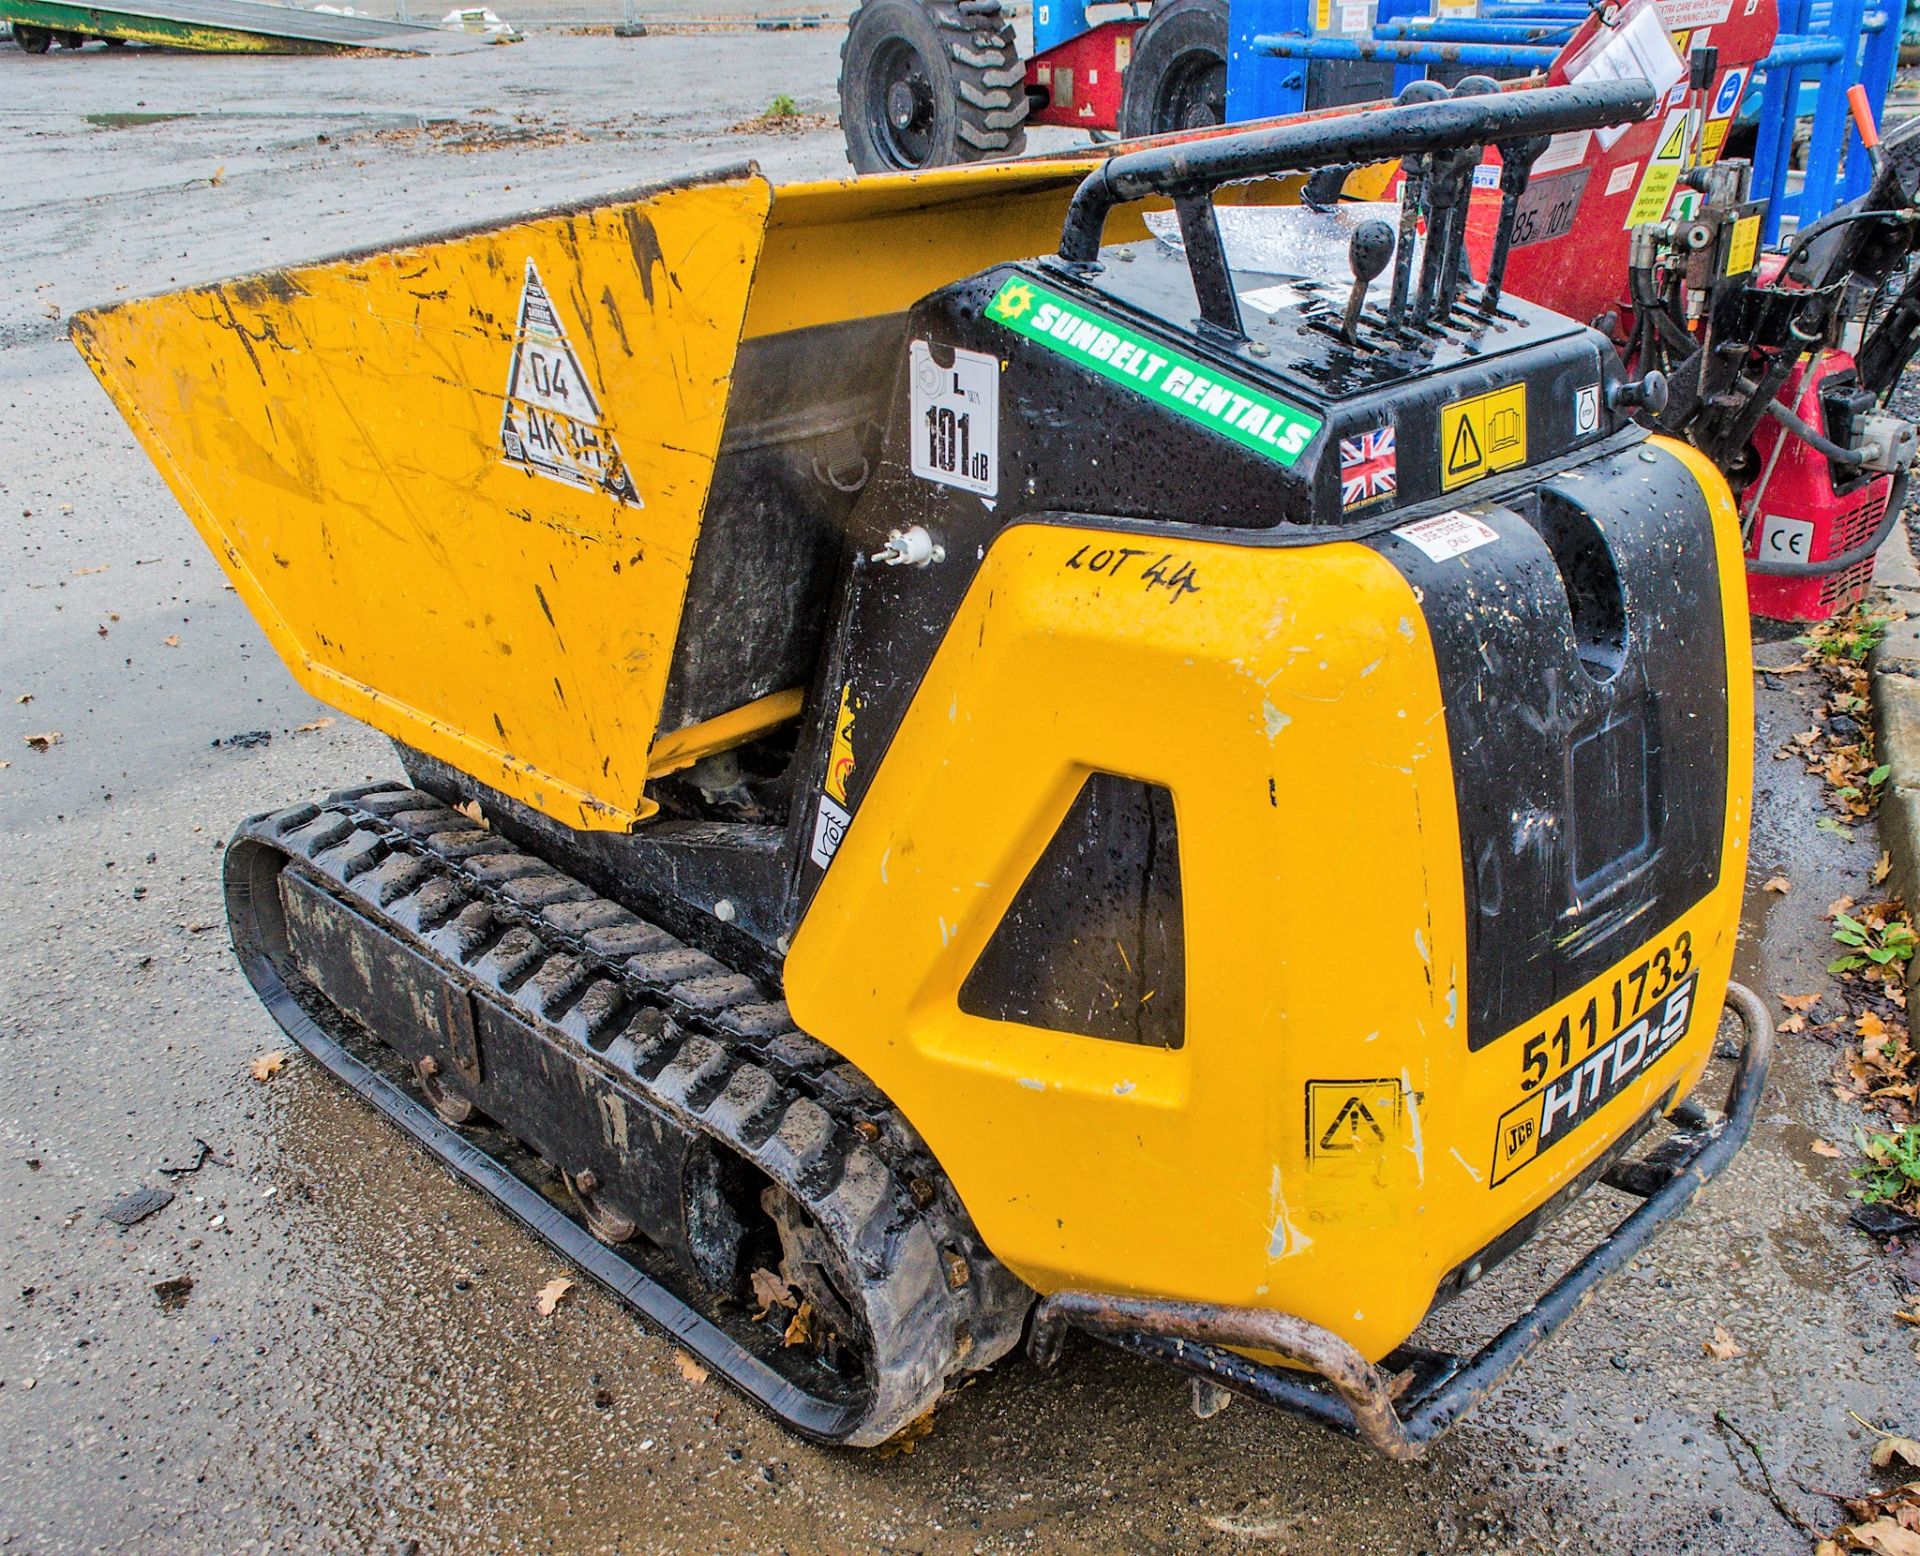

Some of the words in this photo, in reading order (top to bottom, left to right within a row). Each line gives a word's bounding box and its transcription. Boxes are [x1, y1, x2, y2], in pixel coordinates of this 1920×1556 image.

[1510, 209, 1538, 244] 85
[1546, 200, 1572, 235] 101
[530, 351, 569, 400] 04
[1030, 303, 1168, 382] SUNBELT
[1160, 365, 1312, 454] RENTALS
[926, 404, 970, 477] 101
[971, 452, 989, 482] dB
[1416, 530, 1441, 543] USE
[1065, 544, 1147, 577] LOT
[1140, 554, 1200, 604] 44
[1521, 930, 1692, 1091] 5111733
[1540, 980, 1692, 1138] HTD-5
[1508, 1122, 1534, 1155] JCB
